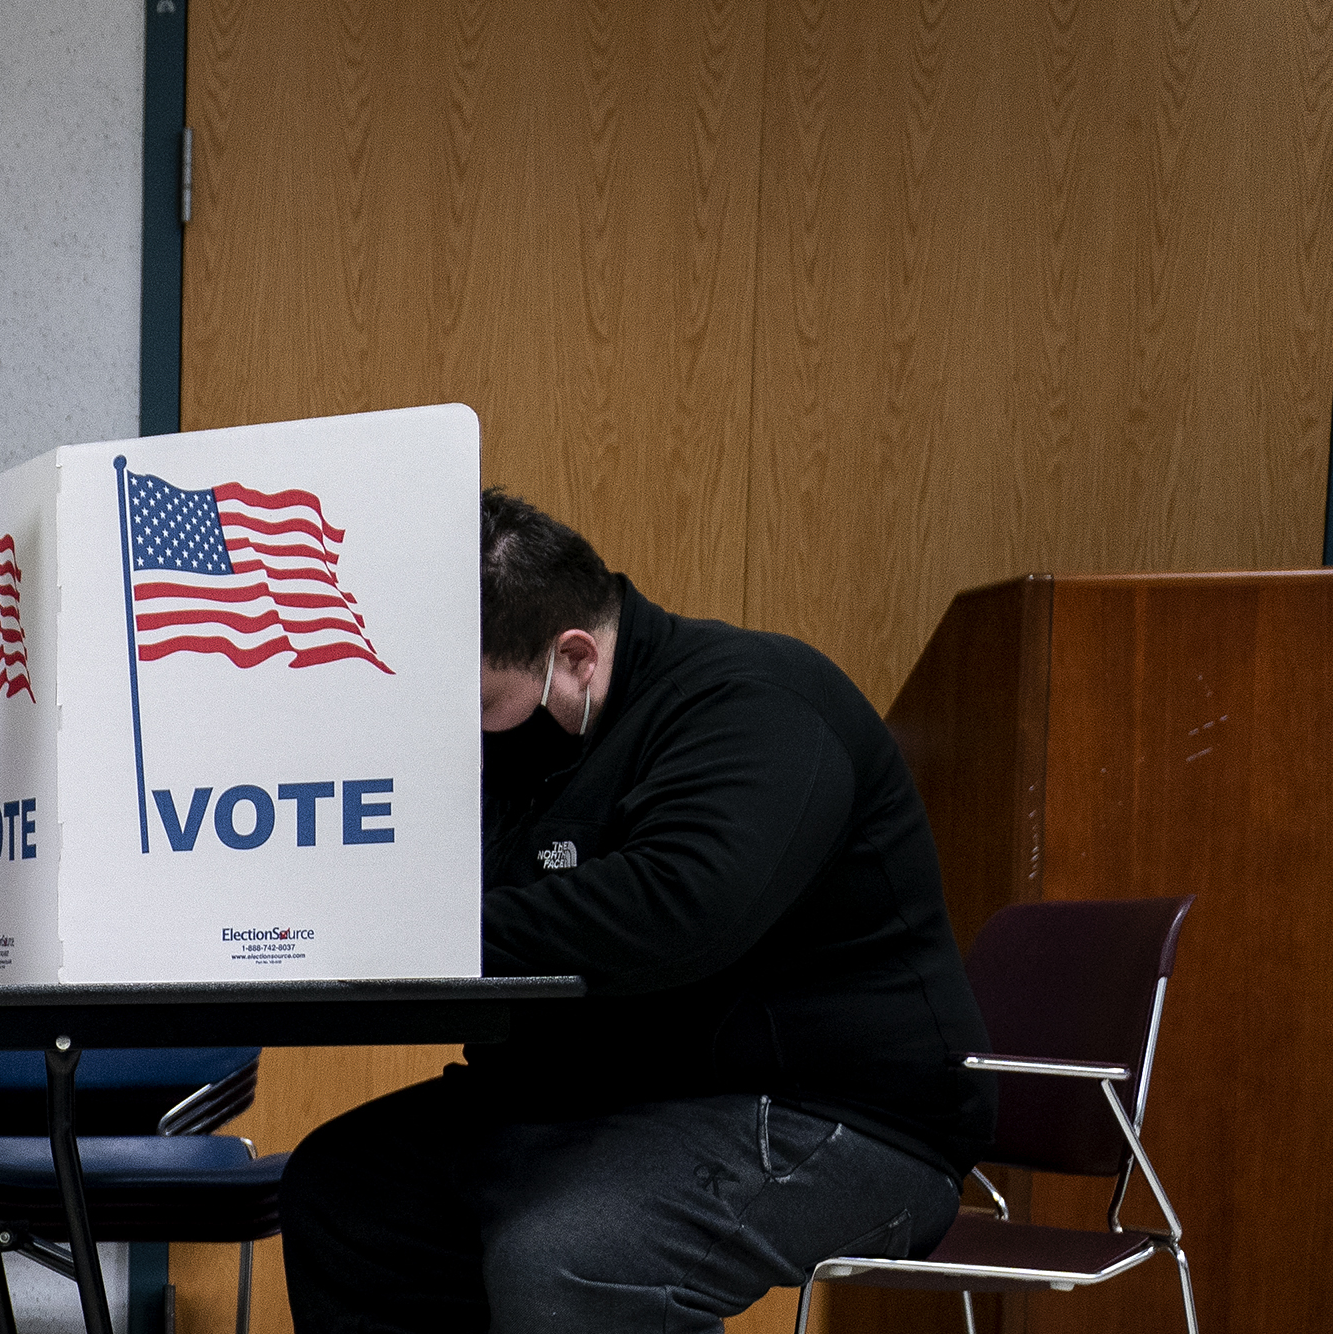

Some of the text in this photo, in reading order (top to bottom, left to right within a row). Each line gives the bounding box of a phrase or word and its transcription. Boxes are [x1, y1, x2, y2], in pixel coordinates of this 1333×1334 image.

[151, 777, 395, 852] VOTE
[552, 841, 569, 852] THE
[537, 850, 566, 860] NORTH
[543, 859, 564, 869] FACE
[242, 944, 296, 952] 1-888-742-8037
